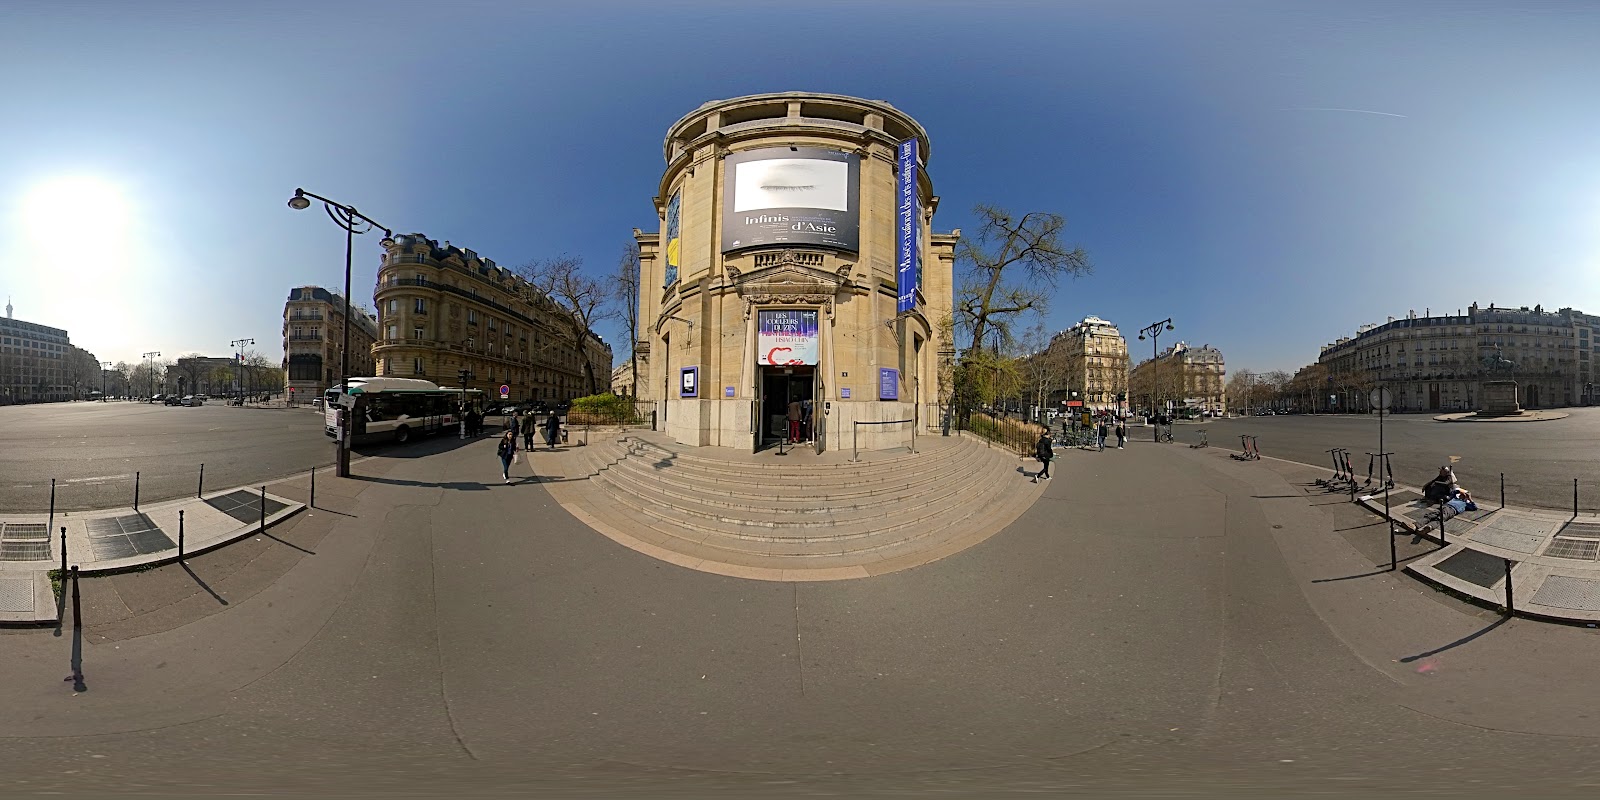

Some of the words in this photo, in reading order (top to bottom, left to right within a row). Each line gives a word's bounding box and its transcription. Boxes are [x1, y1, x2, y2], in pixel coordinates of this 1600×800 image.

[900, 196, 911, 209] des
[745, 213, 789, 224] Infinis
[900, 207, 911, 240] national
[791, 221, 836, 233] d'Asie
